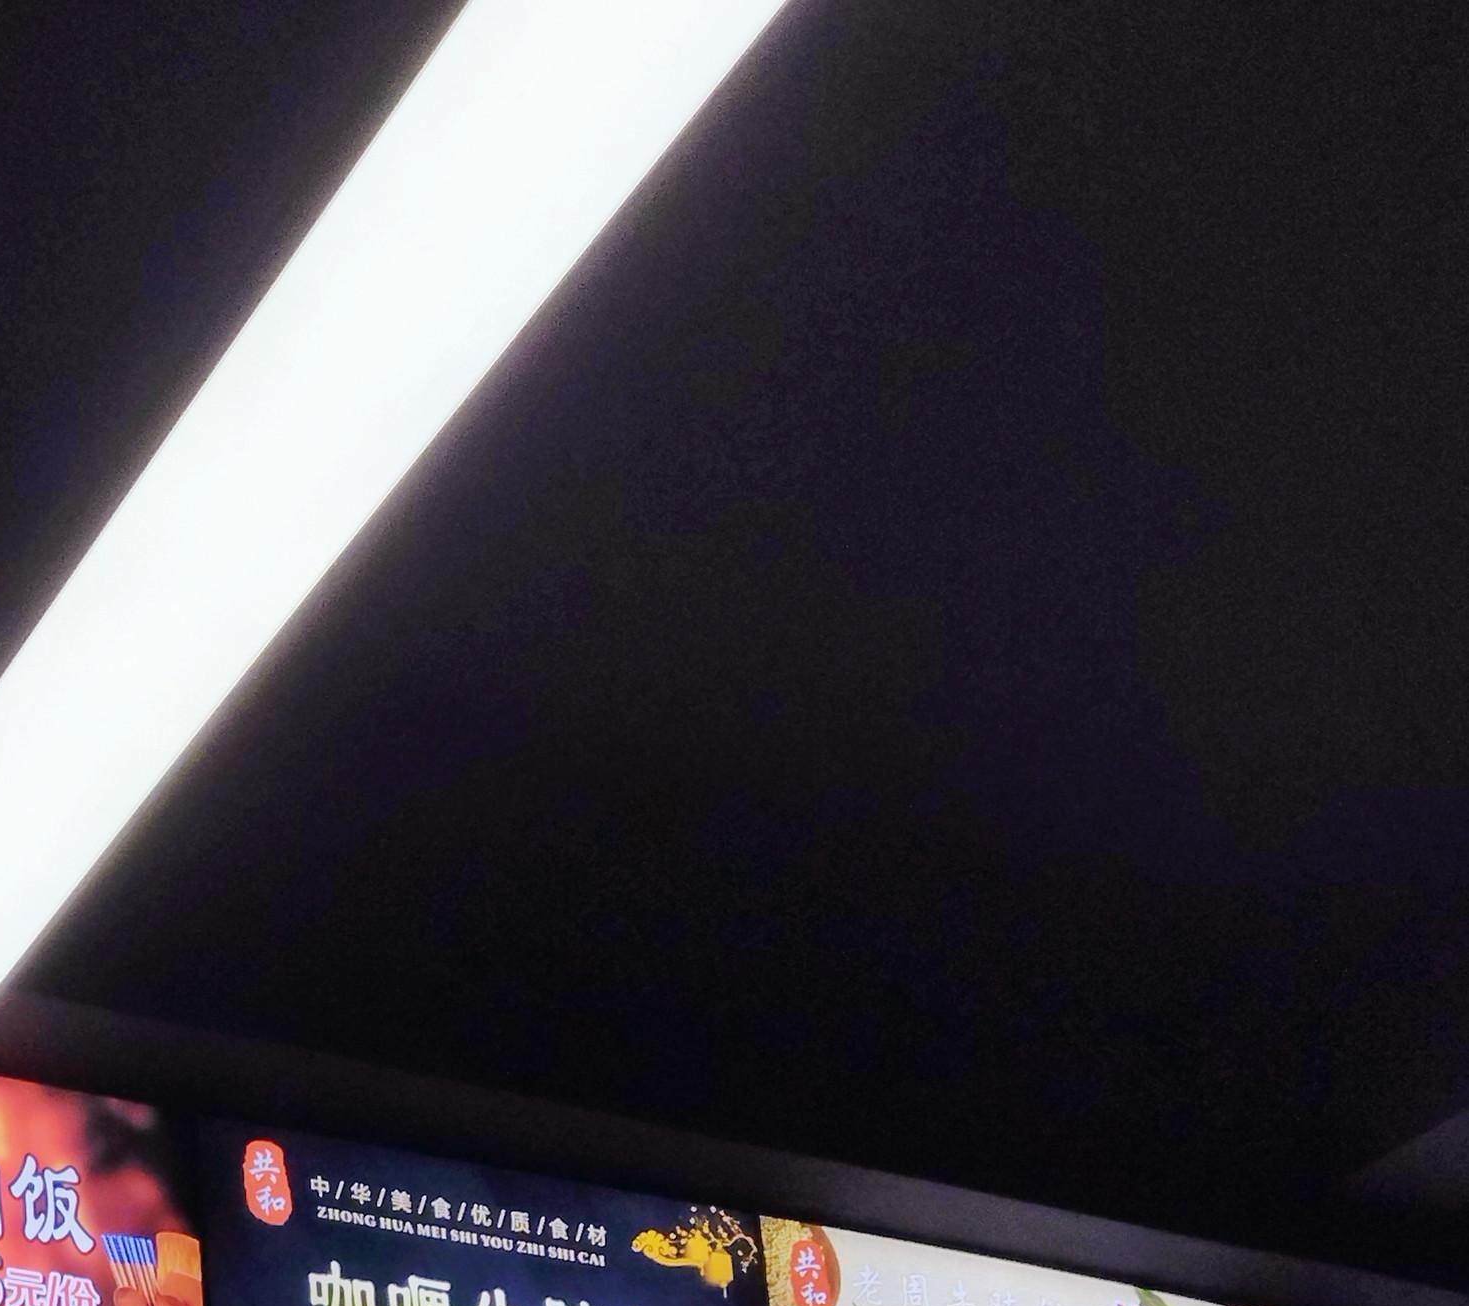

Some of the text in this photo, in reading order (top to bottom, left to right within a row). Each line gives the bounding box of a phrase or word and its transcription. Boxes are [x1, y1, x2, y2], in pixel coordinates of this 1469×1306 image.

[249, 1149, 287, 1216] 共和
[316, 1205, 607, 1268] ZHONG HUA MEI SHI YOU ZHI SHI CAI
